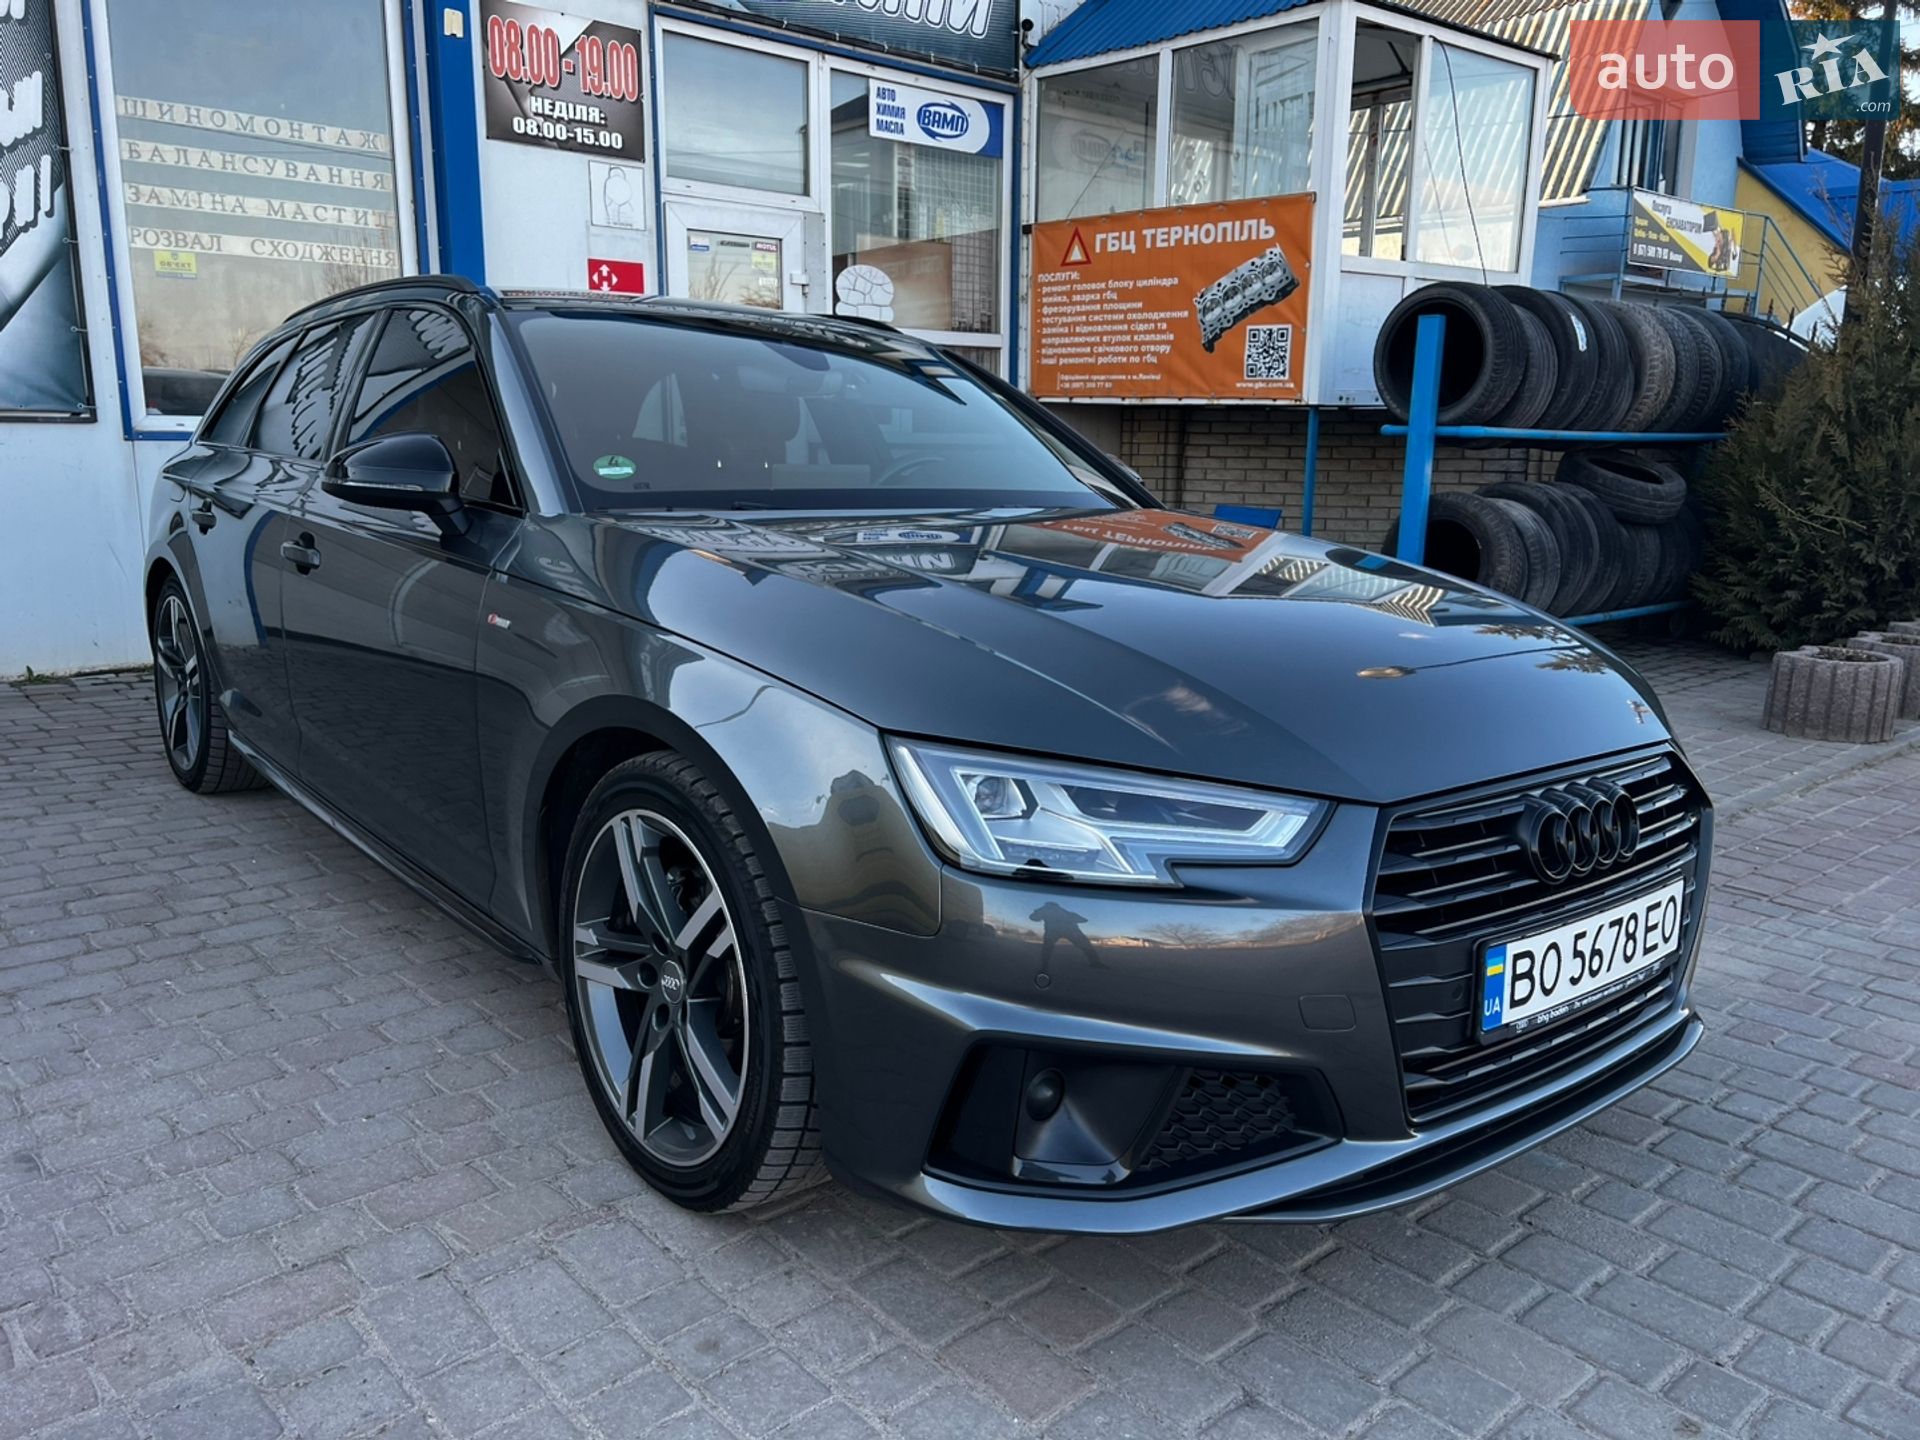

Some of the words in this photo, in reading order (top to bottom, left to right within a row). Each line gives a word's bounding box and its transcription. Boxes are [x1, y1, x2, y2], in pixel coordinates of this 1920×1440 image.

[876, 86, 896, 102] АВТО
[530, 96, 606, 125] НЕДІЛЯ:
[876, 103, 906, 120] ХИМИЯ
[122, 98, 380, 150] ШИНОМОНТАЖ
[512, 116, 623, 149] 08.00-15.00
[876, 119, 904, 135] МАСЛА
[126, 141, 386, 190] БАЛАНСУВАННЯ
[127, 185, 248, 214] ЗАМІНА
[1095, 232, 1136, 254] ГБЦ
[1142, 218, 1276, 249] ТЕРНОПІЛЬ
[130, 227, 223, 251] РОЗВАЛ
[251, 239, 396, 267] СХОДЖЕННЯ
[1042, 284, 1071, 294] ремонт
[1072, 281, 1106, 291] головок
[1108, 279, 1134, 290] блоку
[1136, 276, 1178, 287] циліндра
[1103, 290, 1118, 301] гбц
[1042, 303, 1101, 314] фрезерування
[1103, 300, 1143, 311] площини
[1042, 314, 1086, 326] тестування
[1088, 311, 1124, 322] системи
[1127, 310, 1189, 321] охолодження
[1075, 323, 1128, 334] відновлення
[1130, 321, 1155, 332] сідел
[1157, 322, 1167, 331] та
[1102, 333, 1131, 344] втулок
[1133, 332, 1174, 342] клапанів
[1041, 345, 1091, 356] відновлення
[1092, 344, 1138, 354] свічкового
[1141, 345, 1171, 354] отвору
[1097, 354, 1127, 365] роботи
[1129, 355, 1140, 363] по
[1142, 354, 1157, 364] гбц
[1484, 999, 1501, 1017] UA
